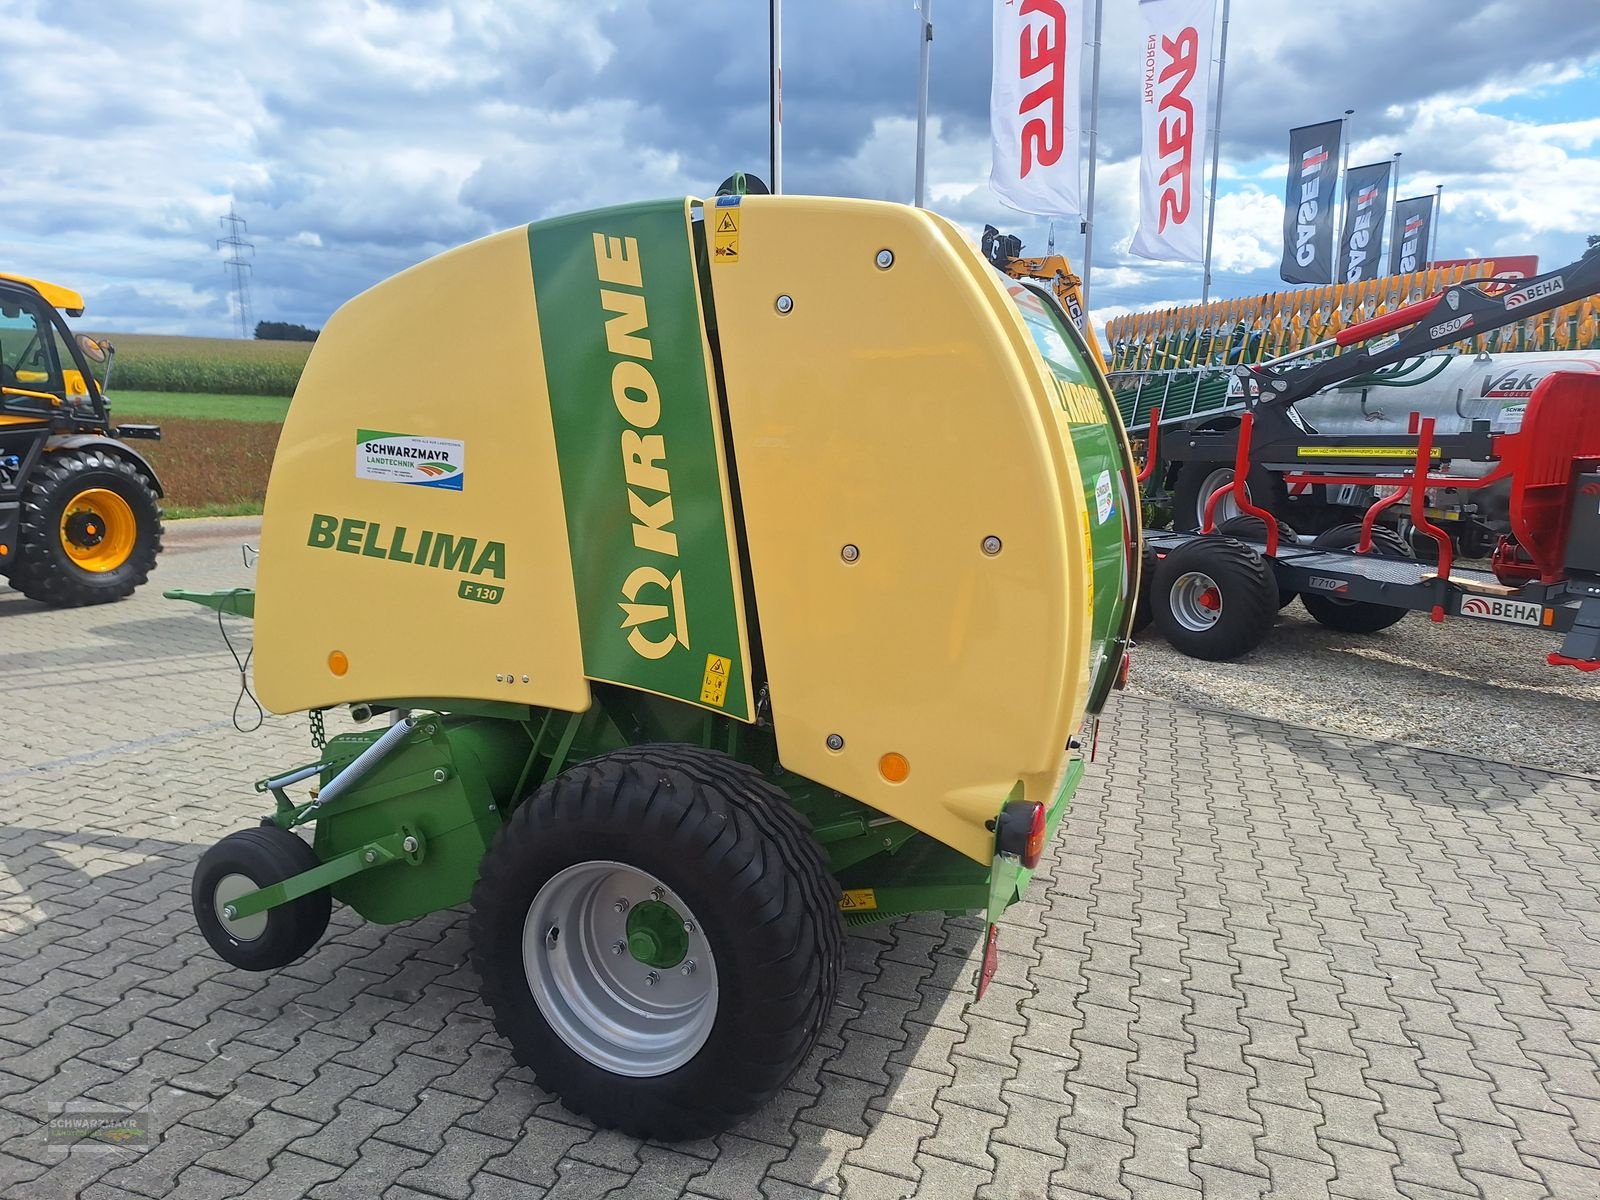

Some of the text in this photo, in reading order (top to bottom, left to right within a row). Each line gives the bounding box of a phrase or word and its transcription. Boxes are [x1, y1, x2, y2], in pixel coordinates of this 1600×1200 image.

[1527, 280, 1562, 299] BEHA
[1431, 319, 1461, 337] 6550
[1481, 369, 1543, 397] Vak
[592, 231, 680, 558] KRONE
[365, 443, 449, 462] SCHWARZMAYR
[366, 457, 415, 468] LANDTECHNIK
[307, 513, 506, 579] BELLIMA
[464, 585, 498, 601] F 130
[1310, 578, 1336, 589] T 710
[1492, 603, 1538, 622] BEHA
